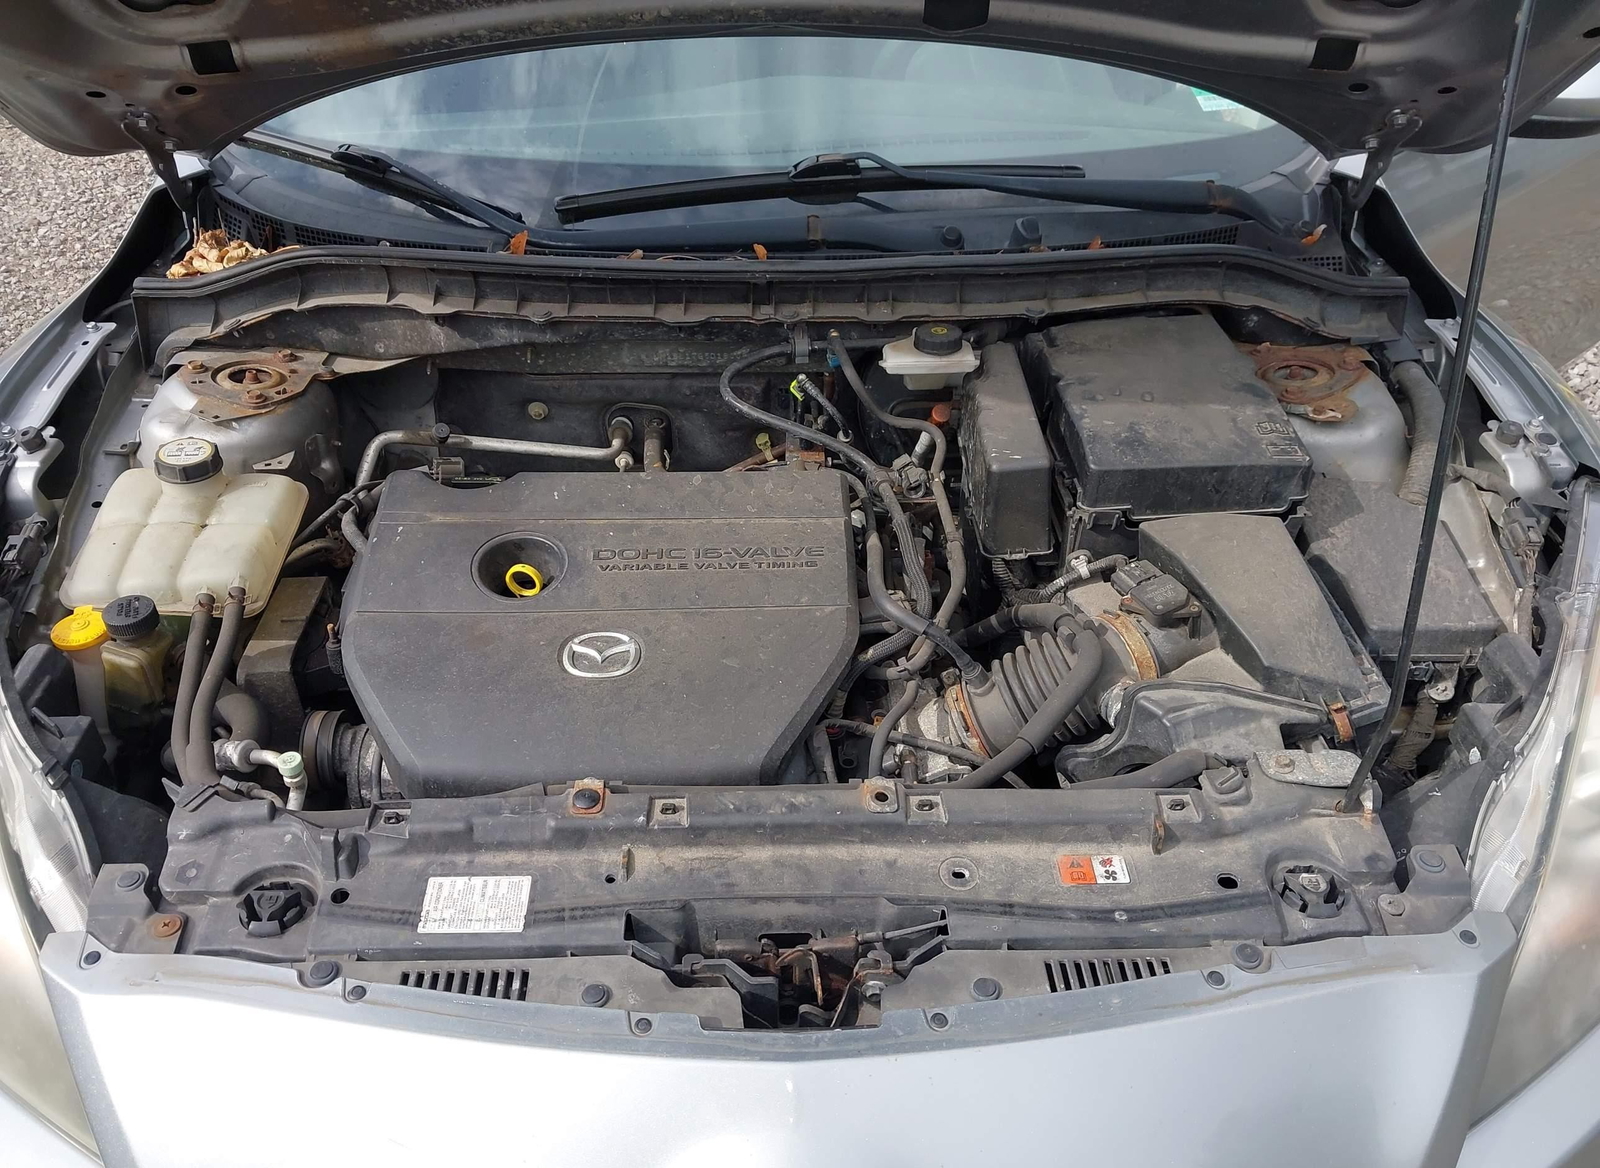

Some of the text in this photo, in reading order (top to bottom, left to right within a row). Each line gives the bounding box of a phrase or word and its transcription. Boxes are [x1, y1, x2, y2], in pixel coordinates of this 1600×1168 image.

[592, 546, 825, 561] DOHC 16-VALVE
[598, 560, 819, 572] VARIABLE VALVE TIMING
